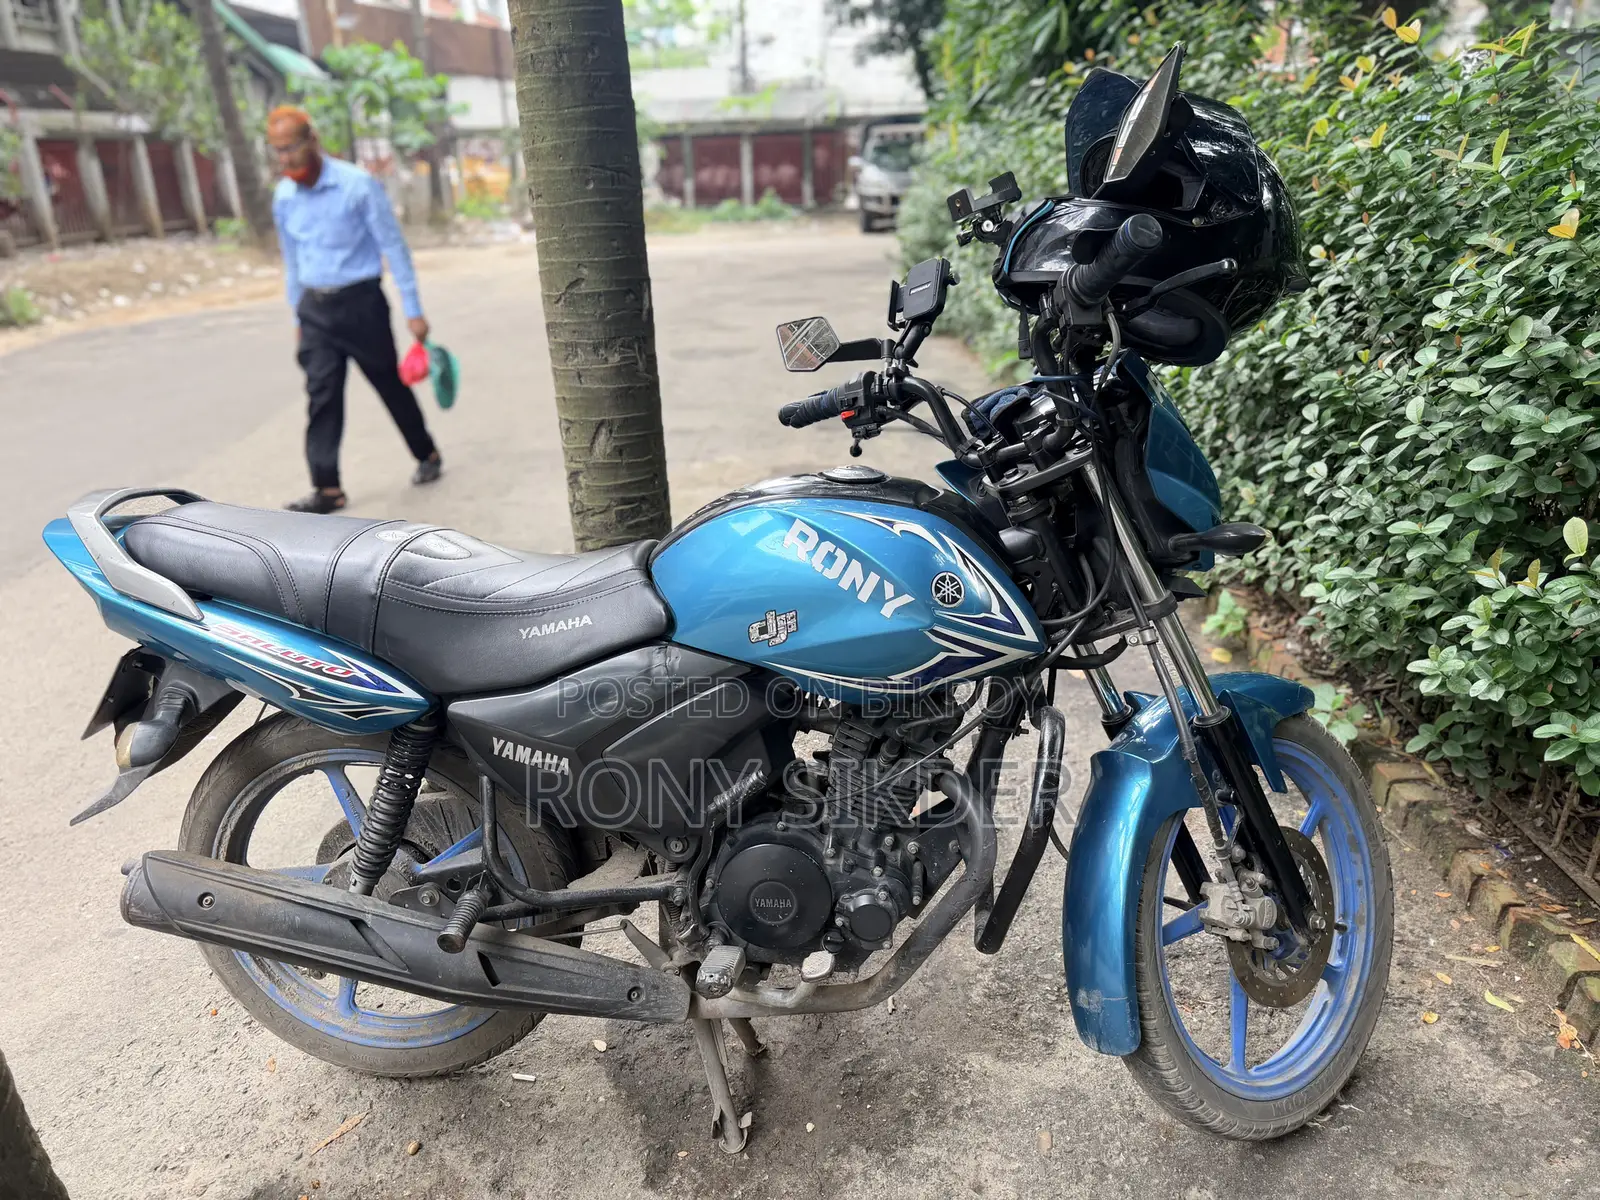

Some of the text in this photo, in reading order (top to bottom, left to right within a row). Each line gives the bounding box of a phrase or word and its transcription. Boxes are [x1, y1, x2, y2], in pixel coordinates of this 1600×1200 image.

[783, 518, 915, 619] RONY
[519, 614, 592, 640] YAMAHA
[492, 736, 570, 776] YAMAHA
[755, 898, 792, 908] YAMAHA
